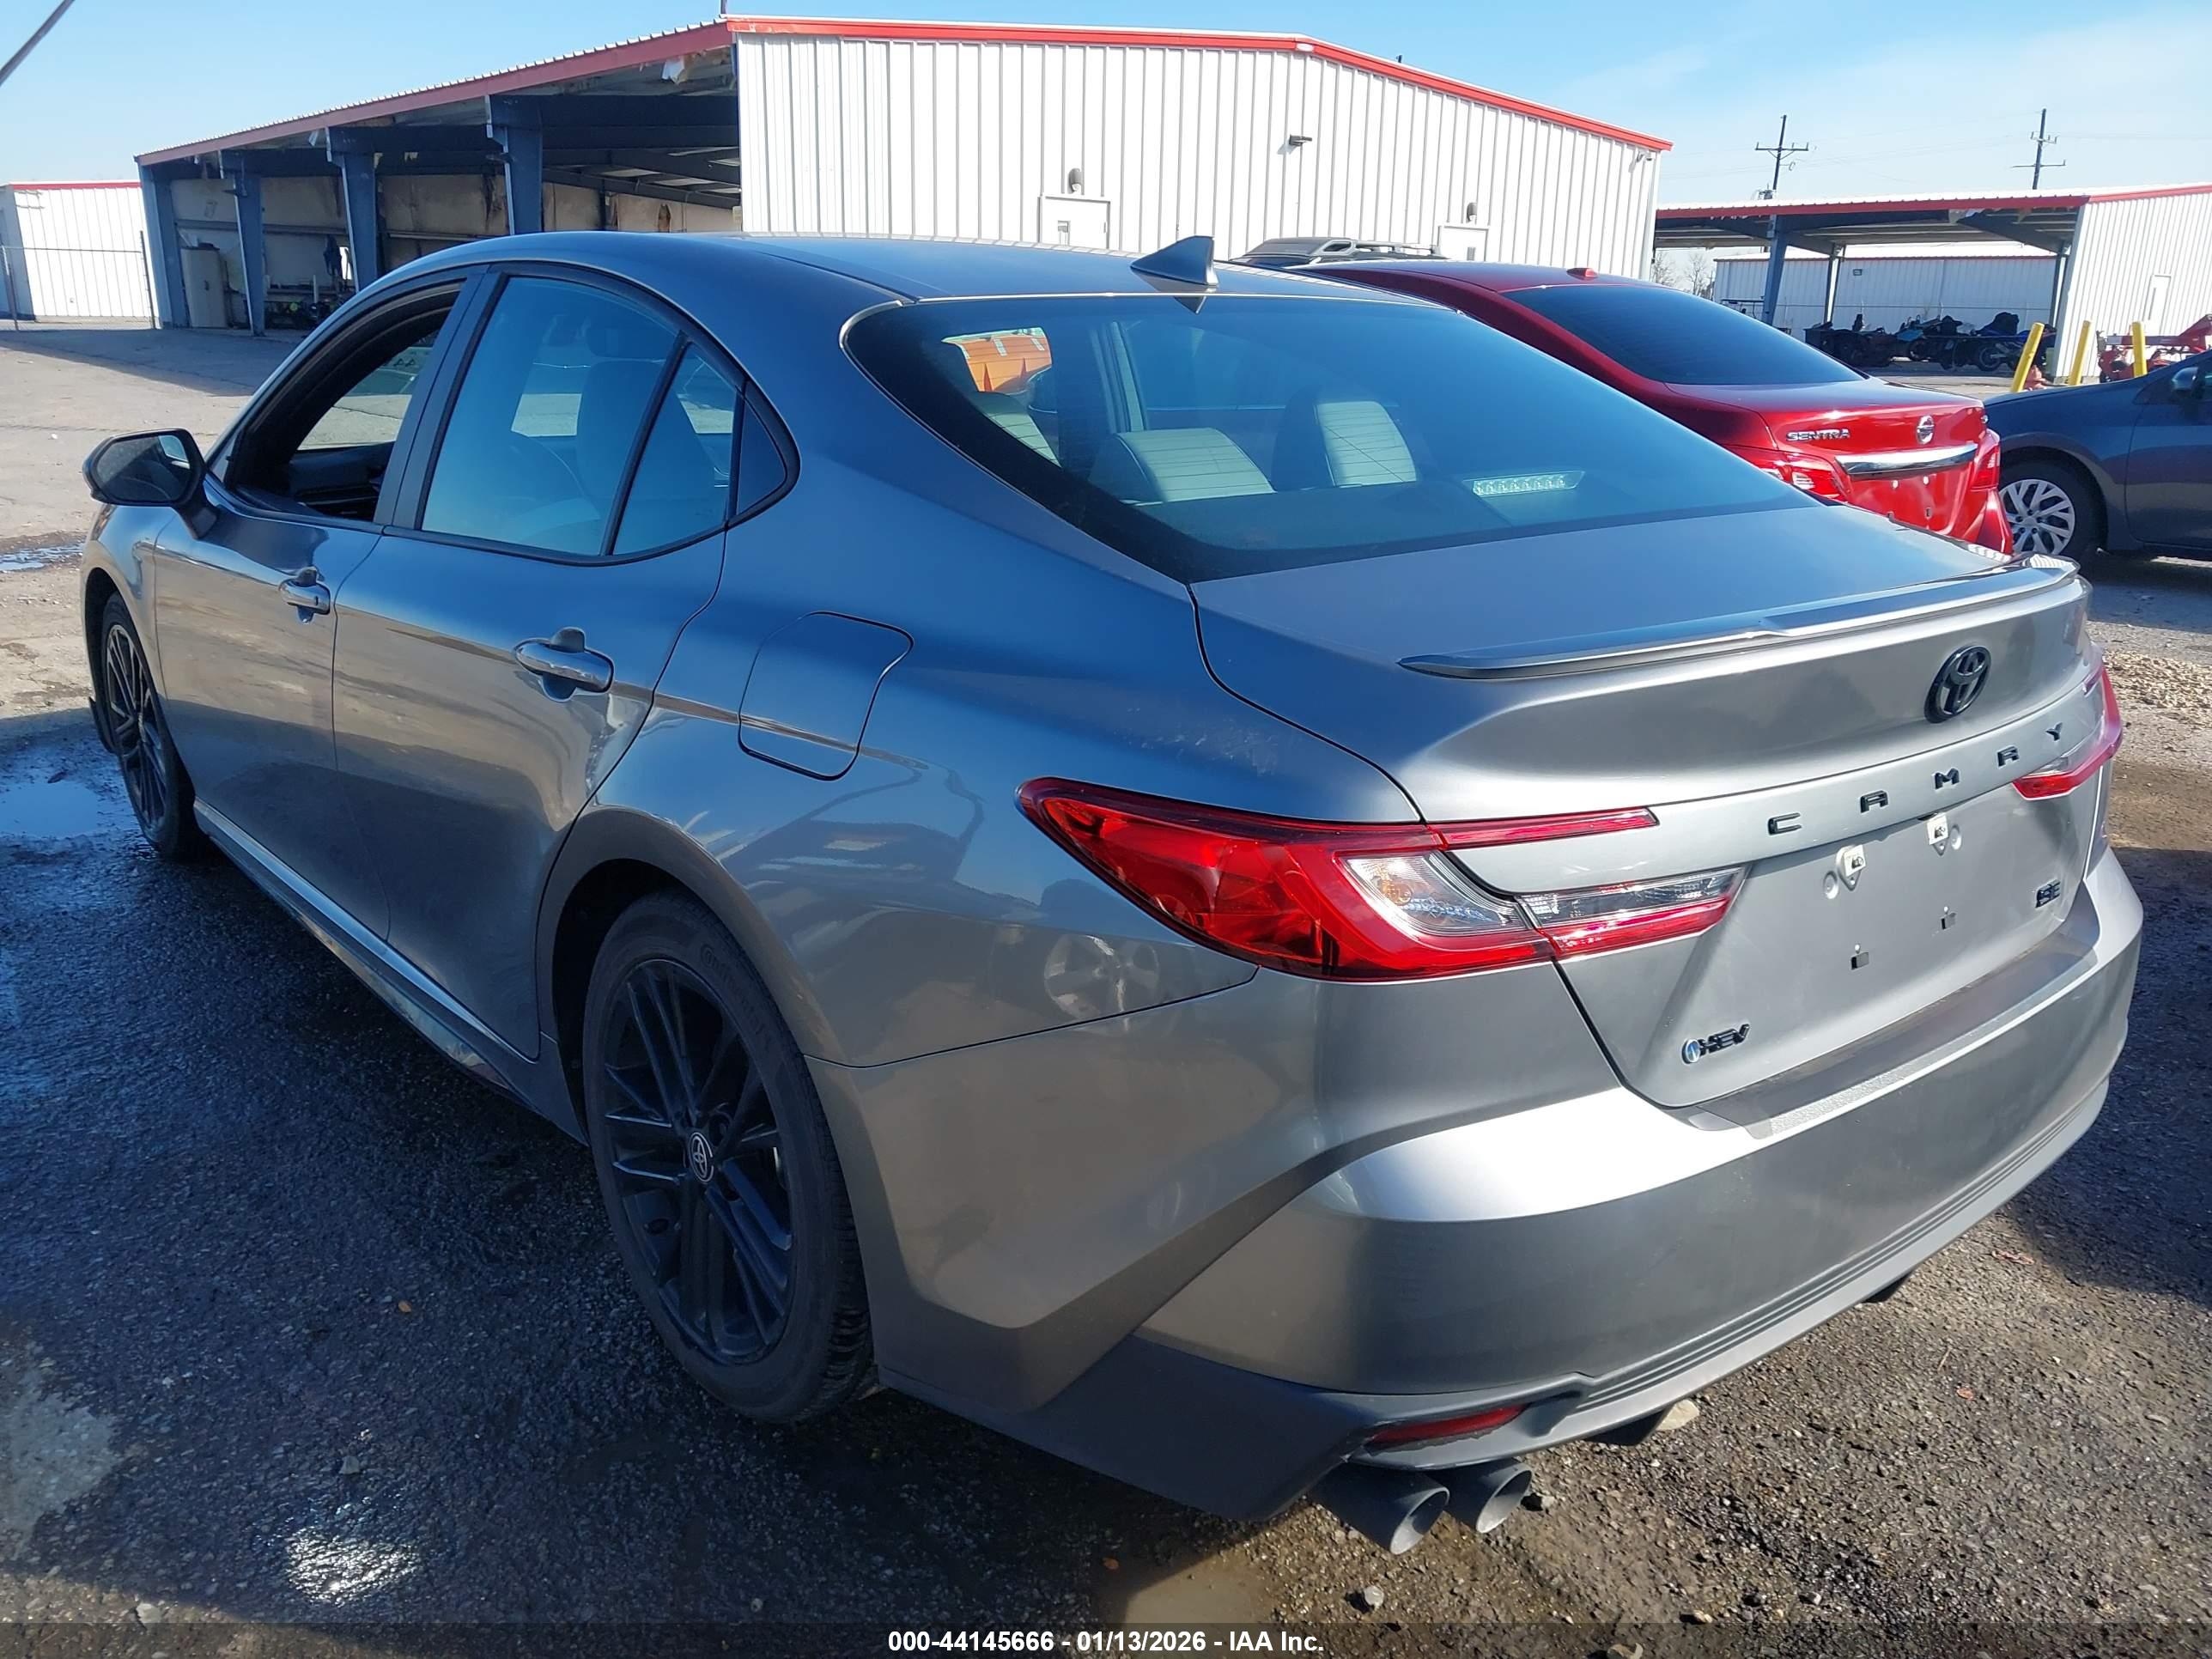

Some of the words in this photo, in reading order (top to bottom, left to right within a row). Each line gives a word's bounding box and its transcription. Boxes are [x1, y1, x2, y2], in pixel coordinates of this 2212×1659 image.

[1785, 428, 1850, 441] SENTRA
[1766, 722, 2063, 836] CAMRY
[1698, 1024, 1750, 1058] HEV
